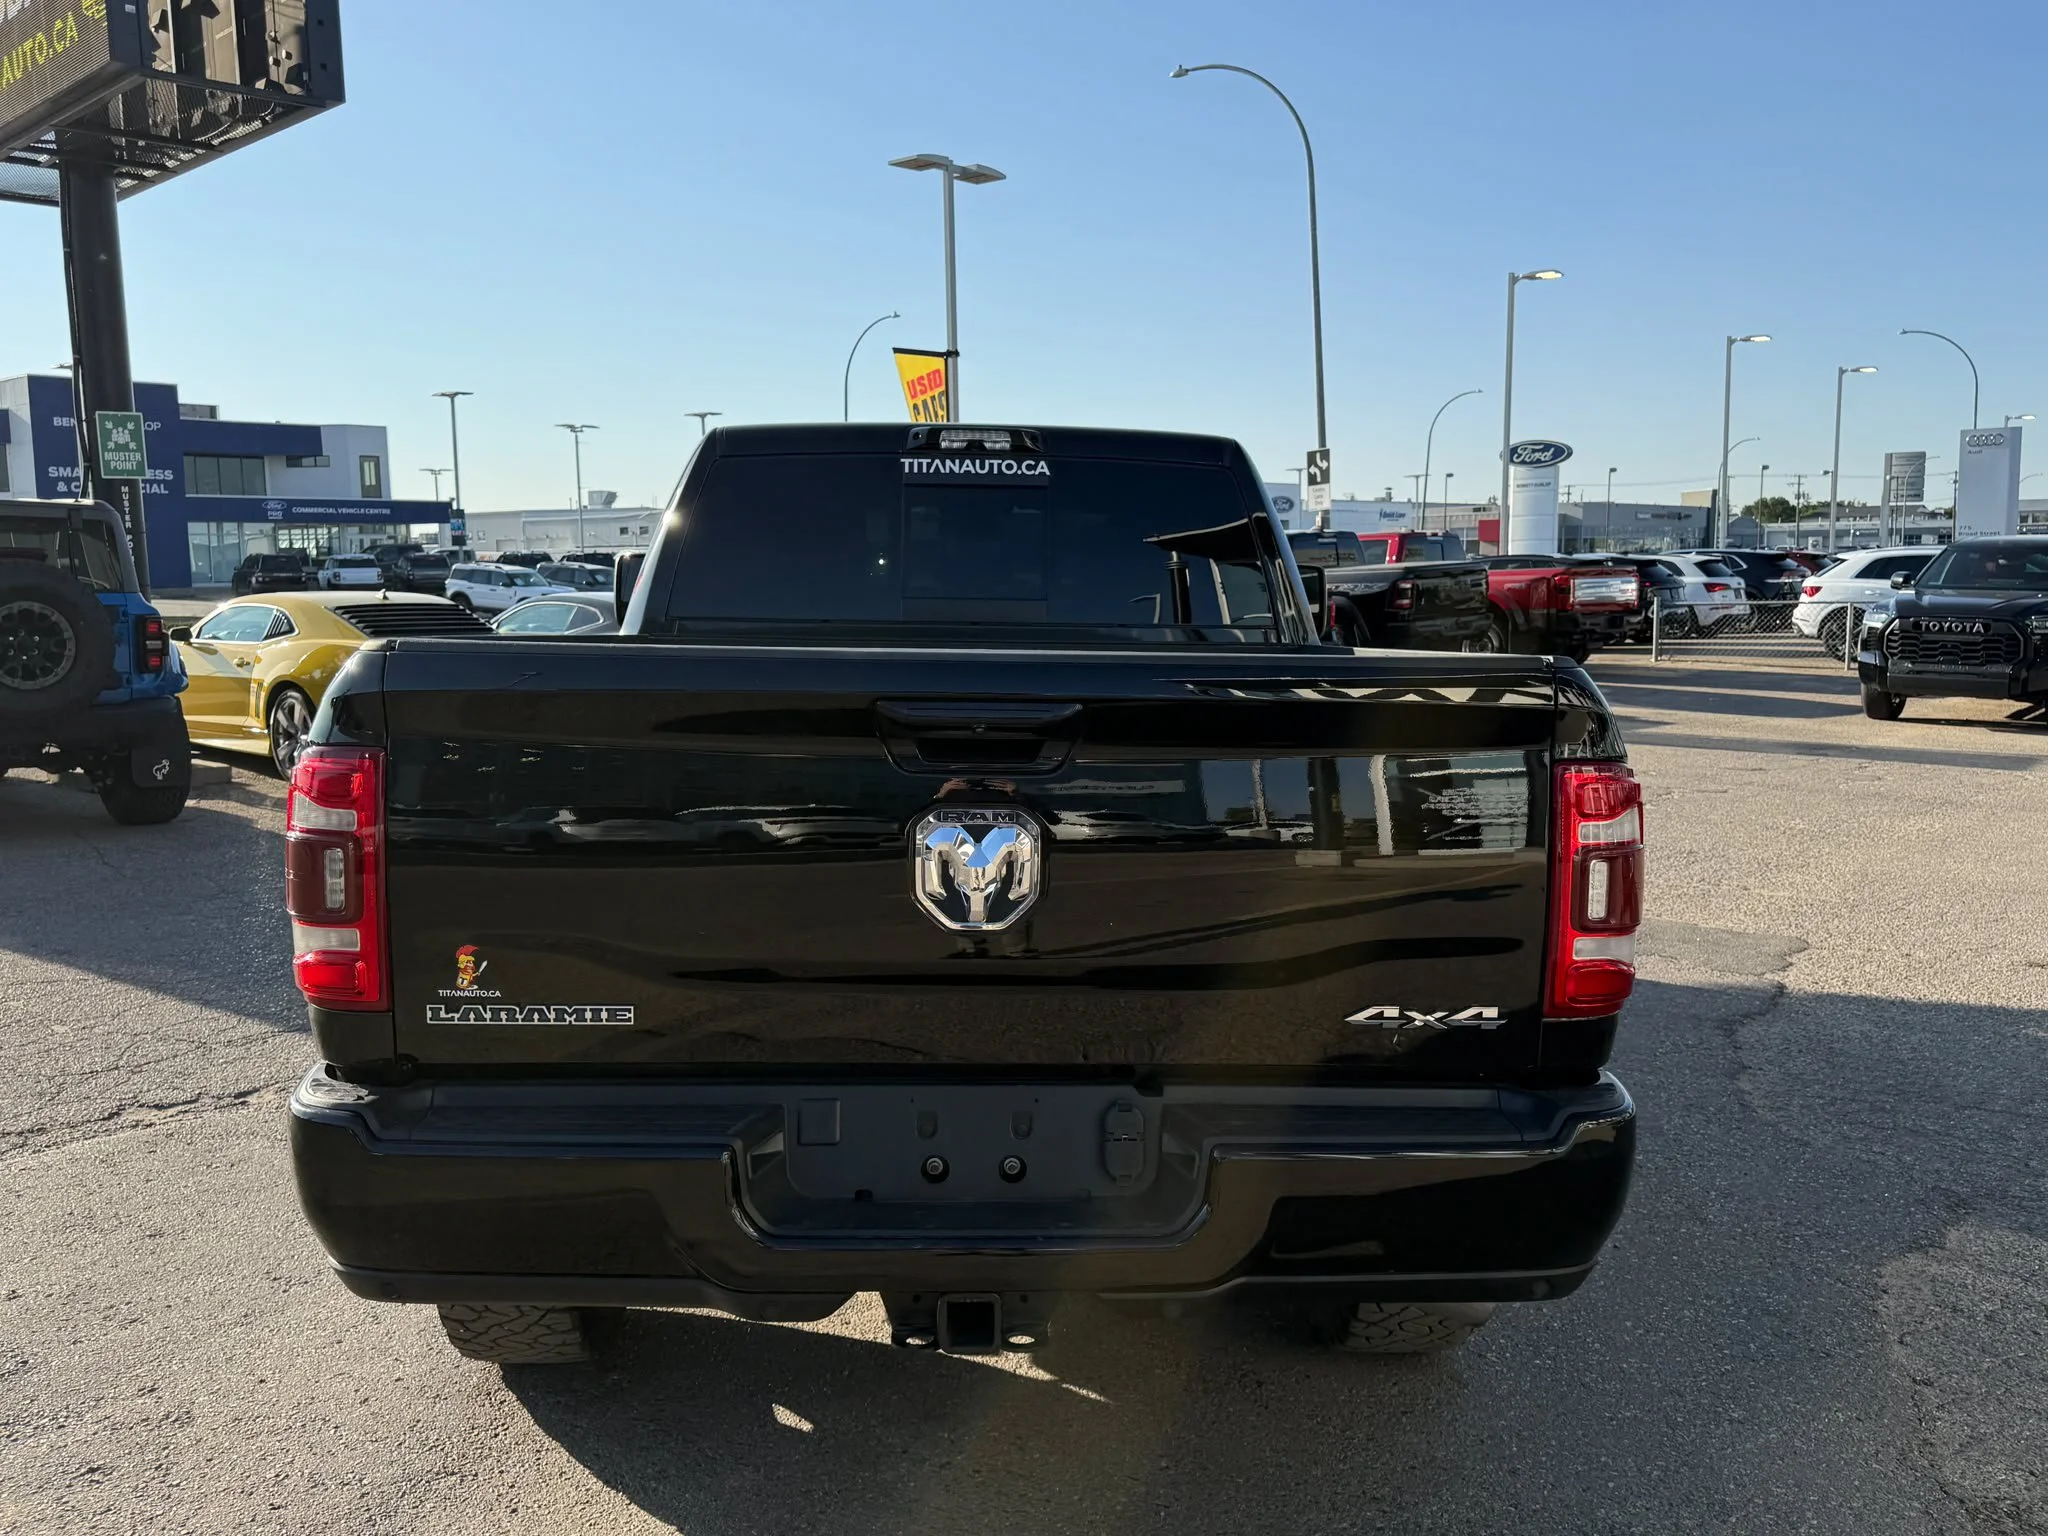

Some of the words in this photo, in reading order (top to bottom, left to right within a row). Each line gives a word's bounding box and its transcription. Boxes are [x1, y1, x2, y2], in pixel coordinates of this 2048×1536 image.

[0, 11, 79, 92] AUTO.CA
[906, 368, 944, 401] USED
[104, 452, 142, 461] MUSTER
[1513, 445, 1555, 463] Ford
[48, 466, 80, 478] SMA
[147, 469, 173, 480] ESS
[110, 461, 137, 470] POINT
[900, 458, 1051, 475] TITANAUTO.CA
[121, 486, 132, 528] MUSTER
[1919, 620, 1985, 634] TOYOTA
[940, 810, 1017, 824] RAM
[438, 989, 501, 997] TITANAUTO.CA
[426, 1005, 634, 1025] LARAMIE
